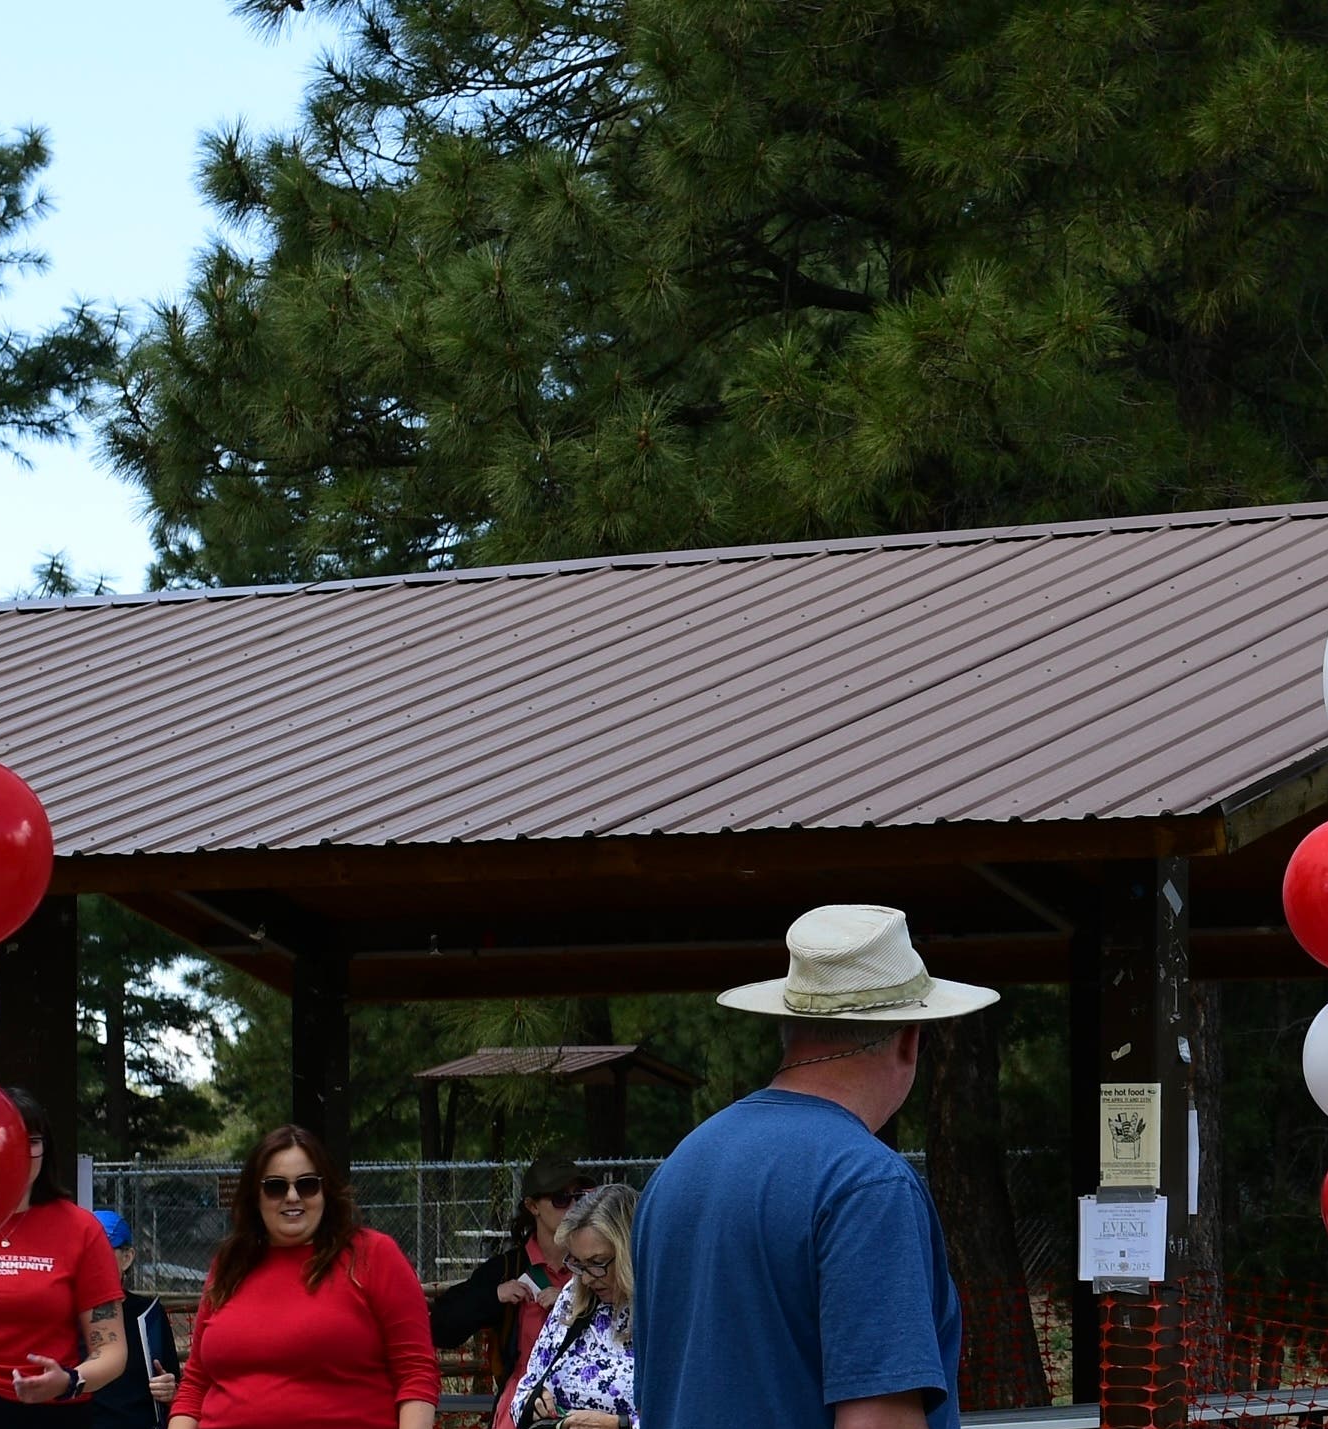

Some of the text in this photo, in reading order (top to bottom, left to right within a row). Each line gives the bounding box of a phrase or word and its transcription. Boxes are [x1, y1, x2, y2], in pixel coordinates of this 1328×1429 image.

[1114, 1088, 1126, 1096] hot
[1128, 1088, 1145, 1096] food
[1102, 1221, 1146, 1233] EVENT
[19, 1255, 54, 1264] SUPPORT
